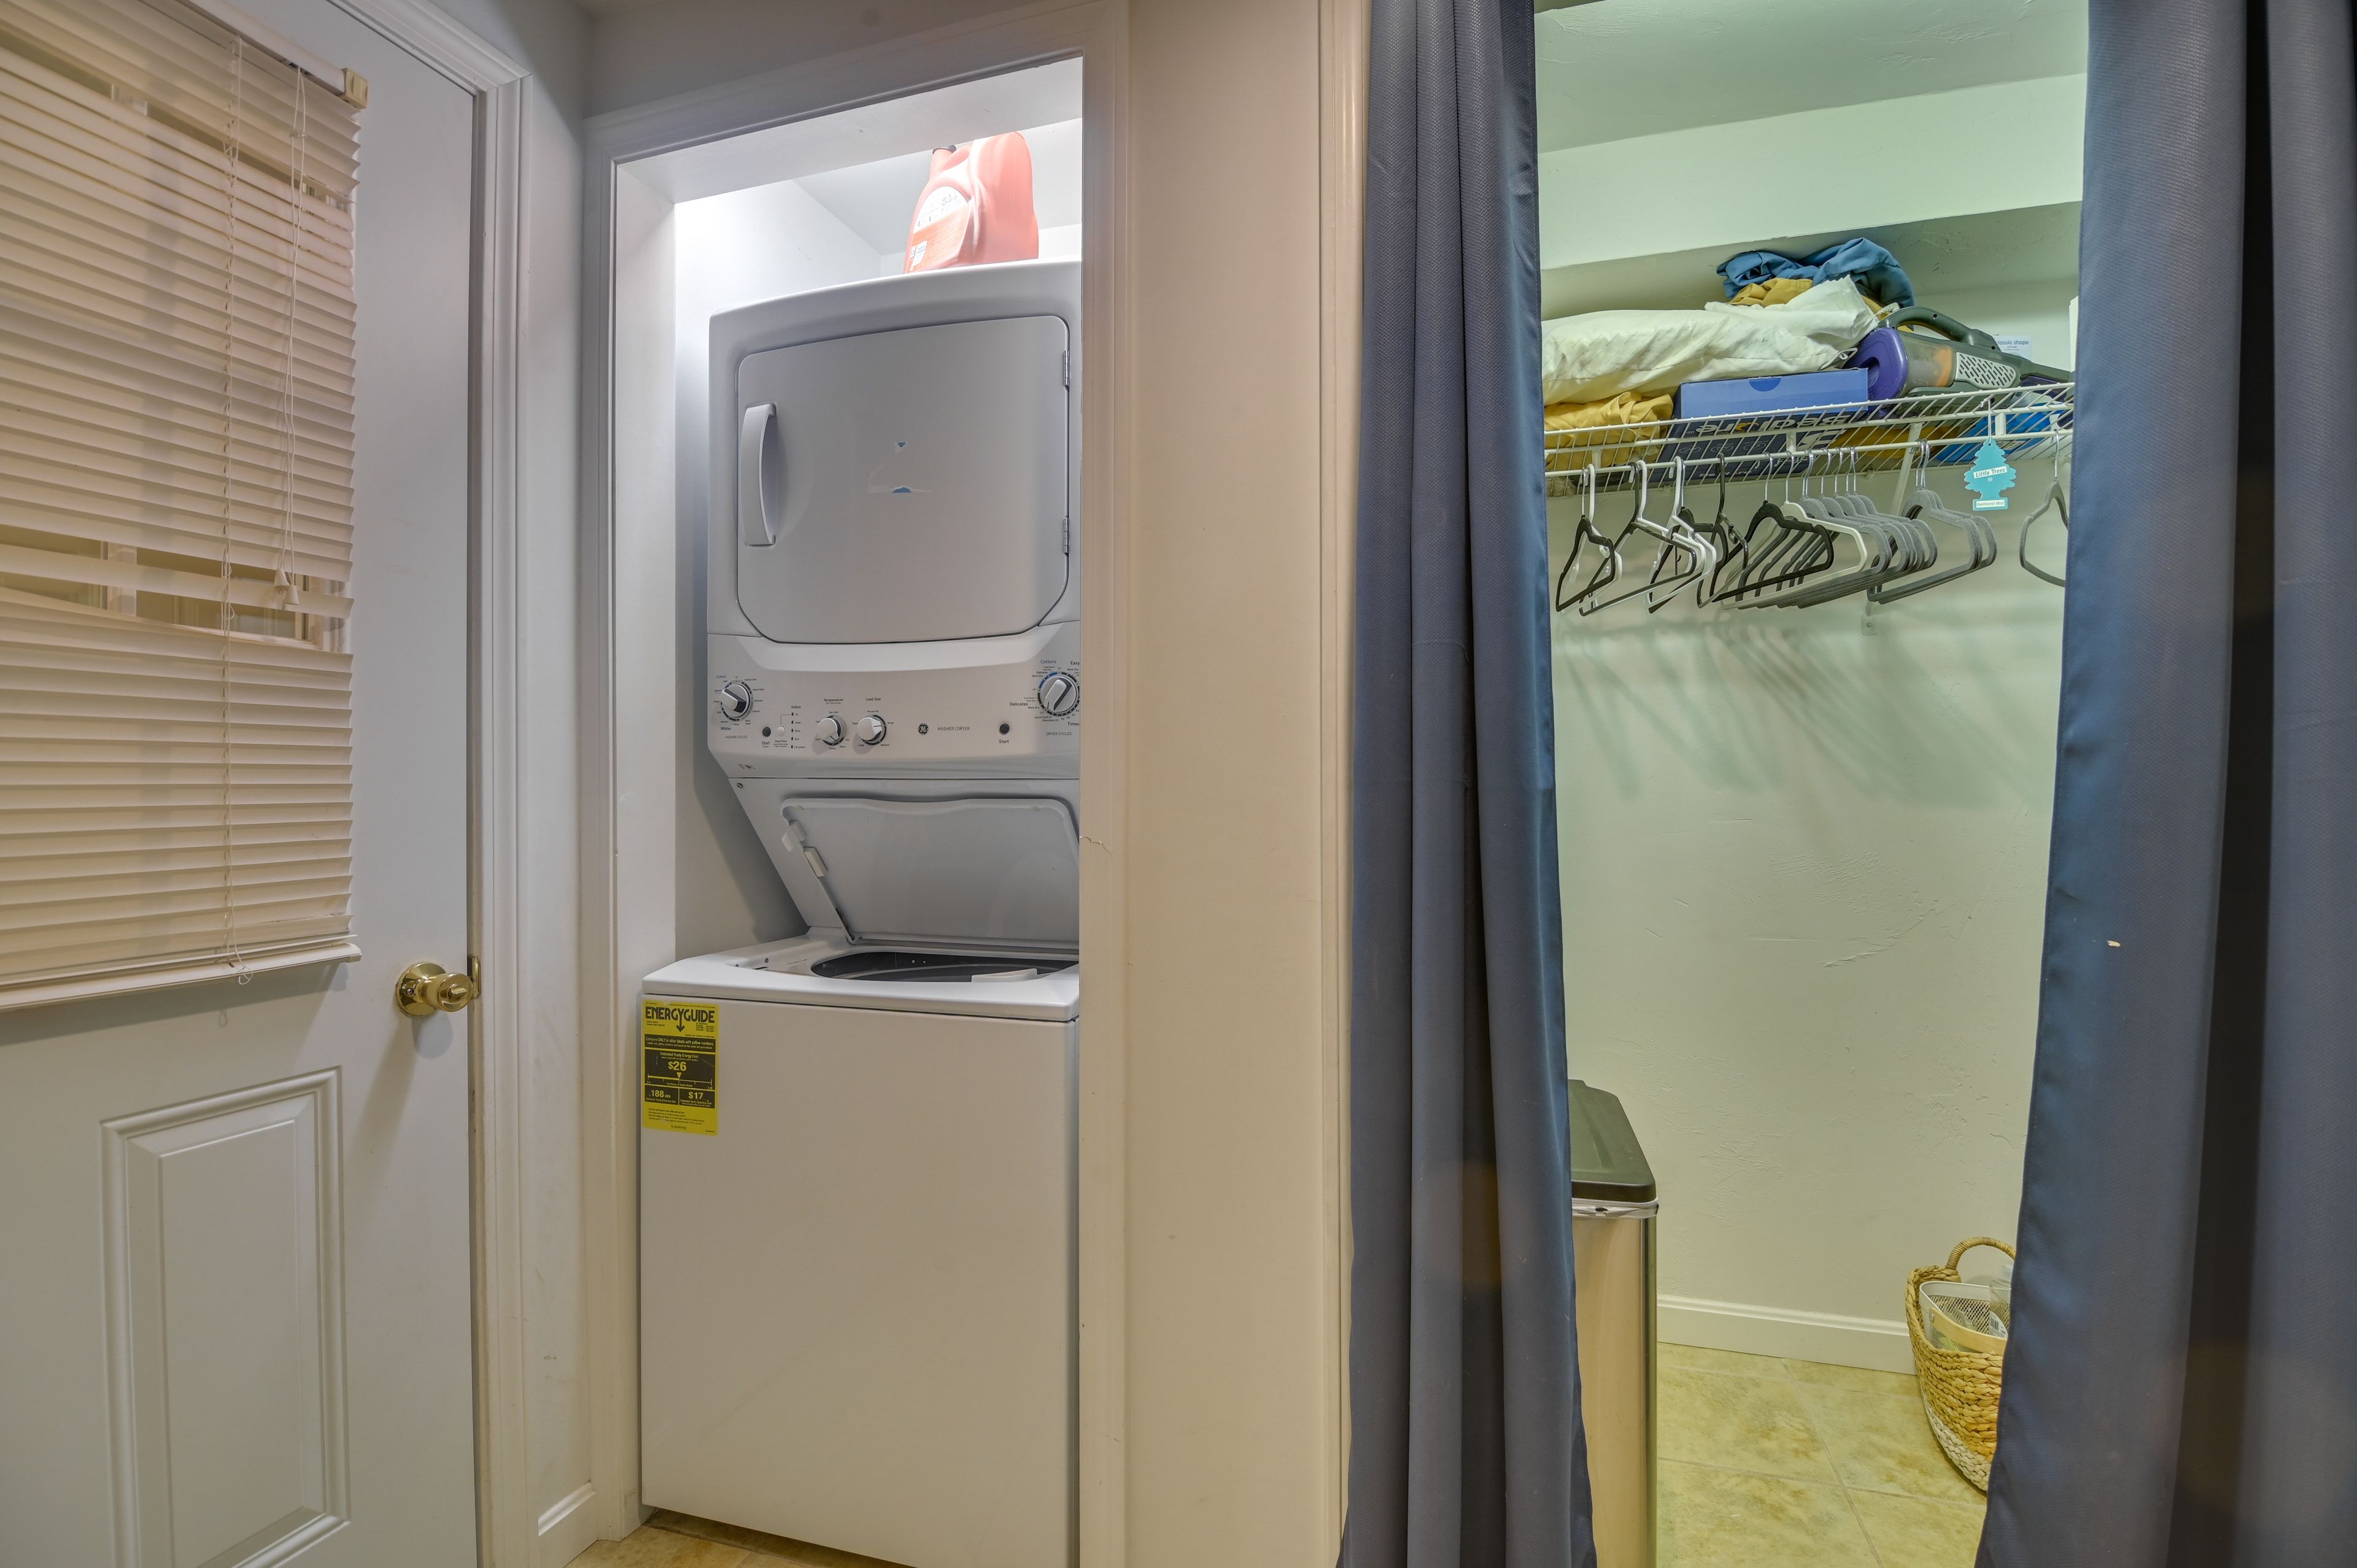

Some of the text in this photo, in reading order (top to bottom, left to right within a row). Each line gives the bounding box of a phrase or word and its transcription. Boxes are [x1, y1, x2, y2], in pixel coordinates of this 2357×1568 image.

[645, 1006, 715, 1024] ENERGYGUIDE
[668, 1060, 687, 1072] $26
[651, 1089, 664, 1098] 188
